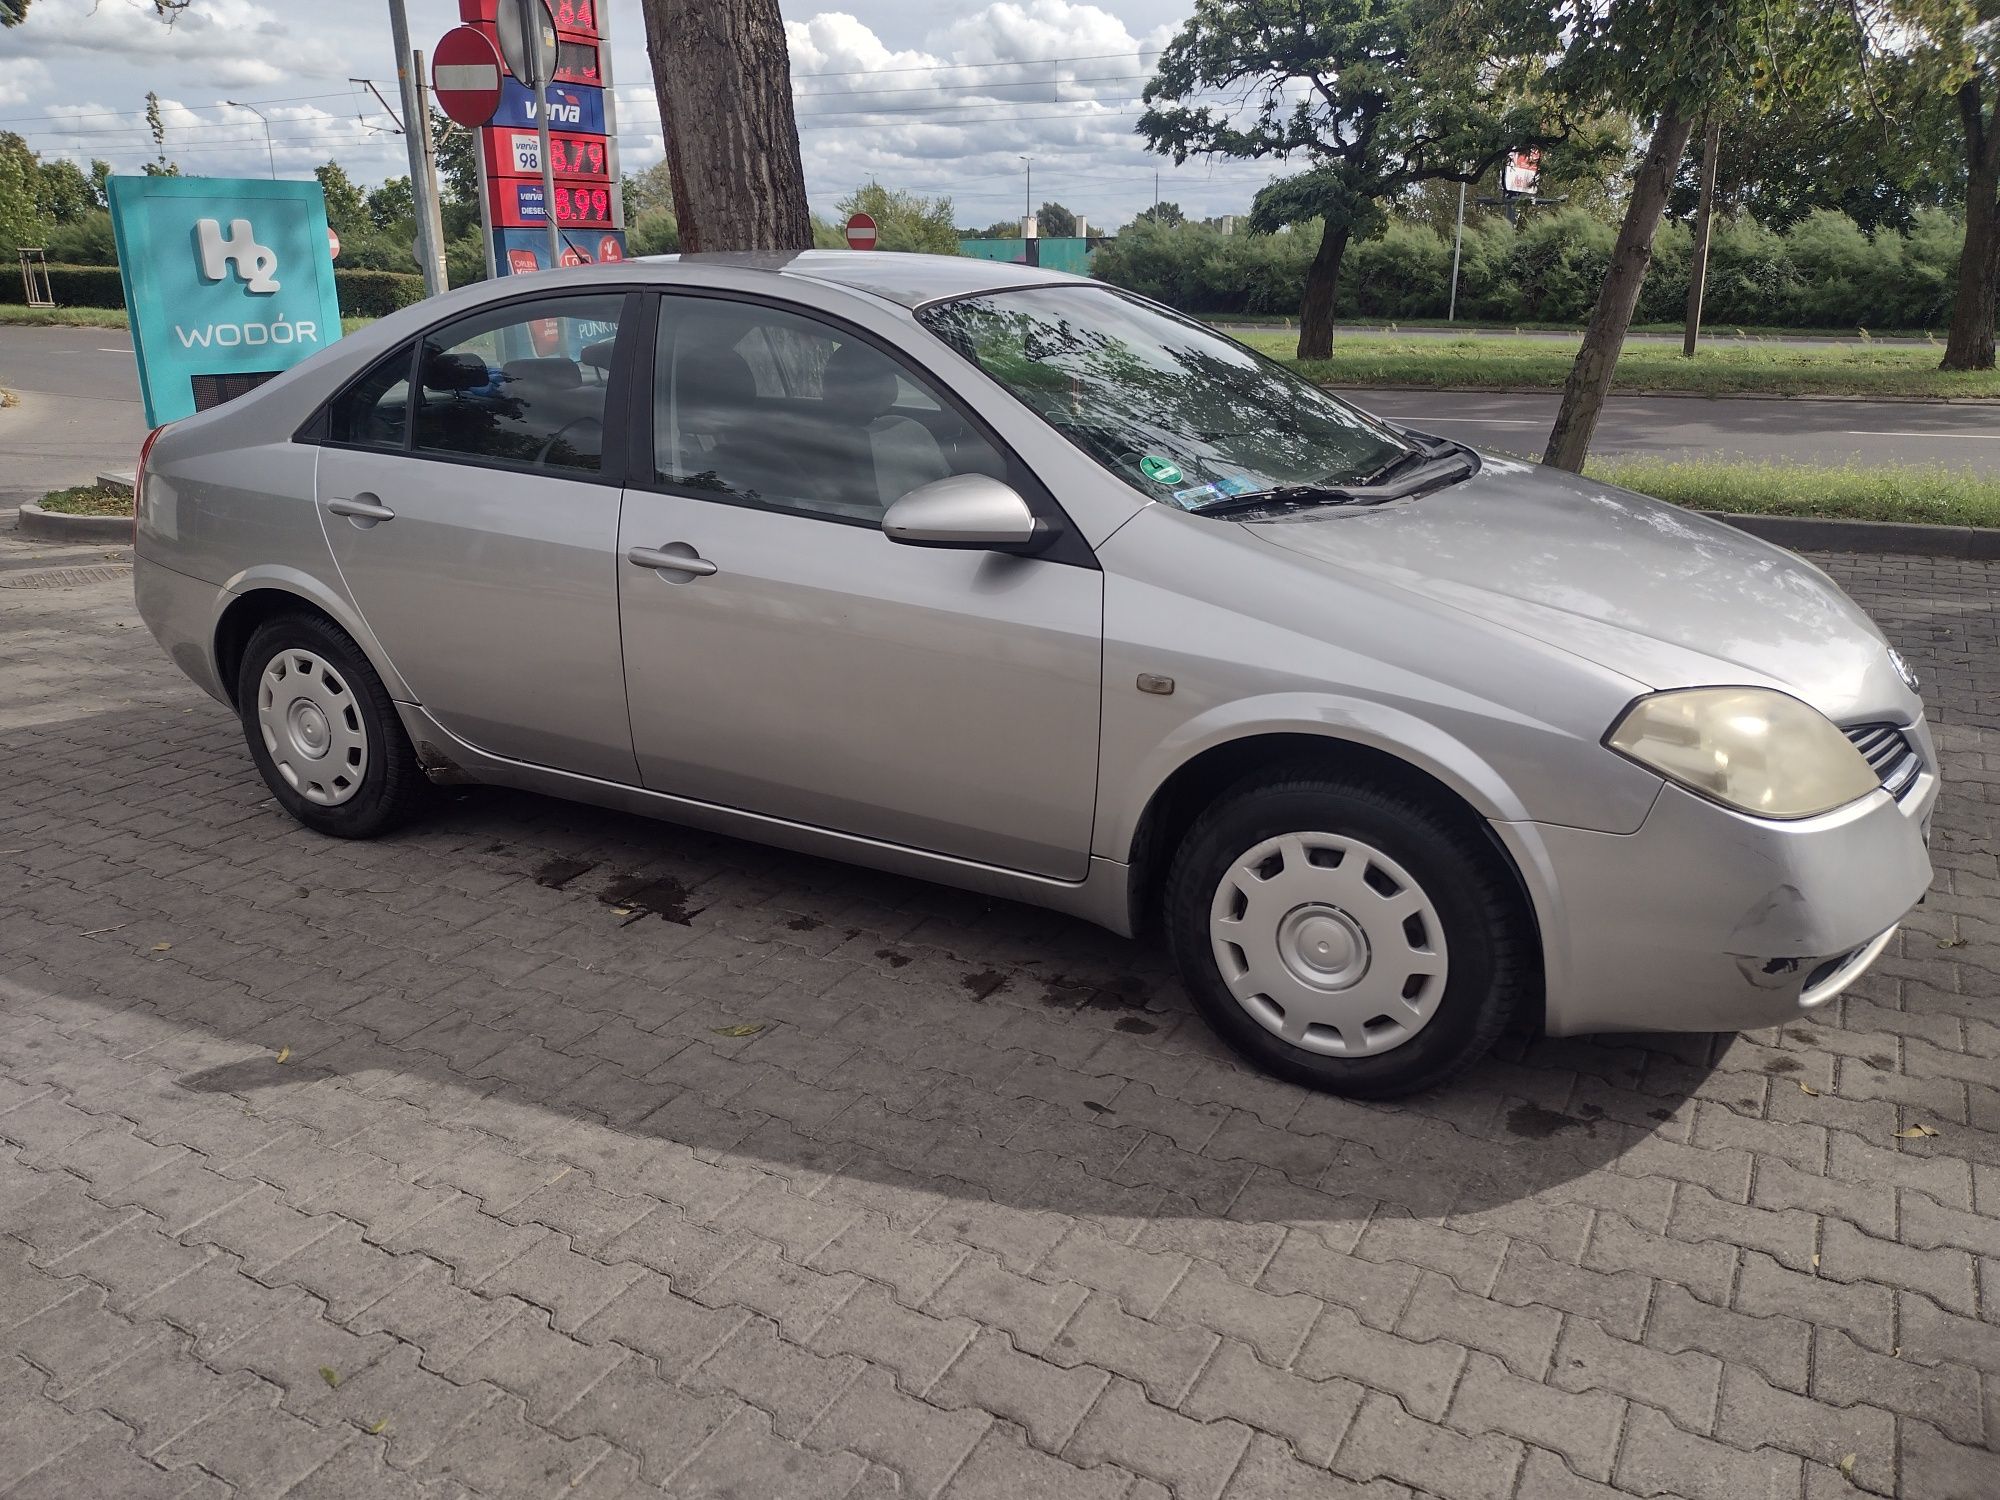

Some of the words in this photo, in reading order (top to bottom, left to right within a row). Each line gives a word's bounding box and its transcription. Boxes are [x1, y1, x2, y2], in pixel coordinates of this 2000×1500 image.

[515, 143, 538, 151] verva
[519, 153, 538, 169] 98
[551, 140, 603, 173] 8.79
[520, 192, 543, 201] verva
[555, 188, 607, 220] 8.99
[521, 206, 546, 215] DIESEL
[197, 218, 281, 293] H2
[175, 312, 318, 348] WODÓR
[1146, 458, 1165, 470] 4
